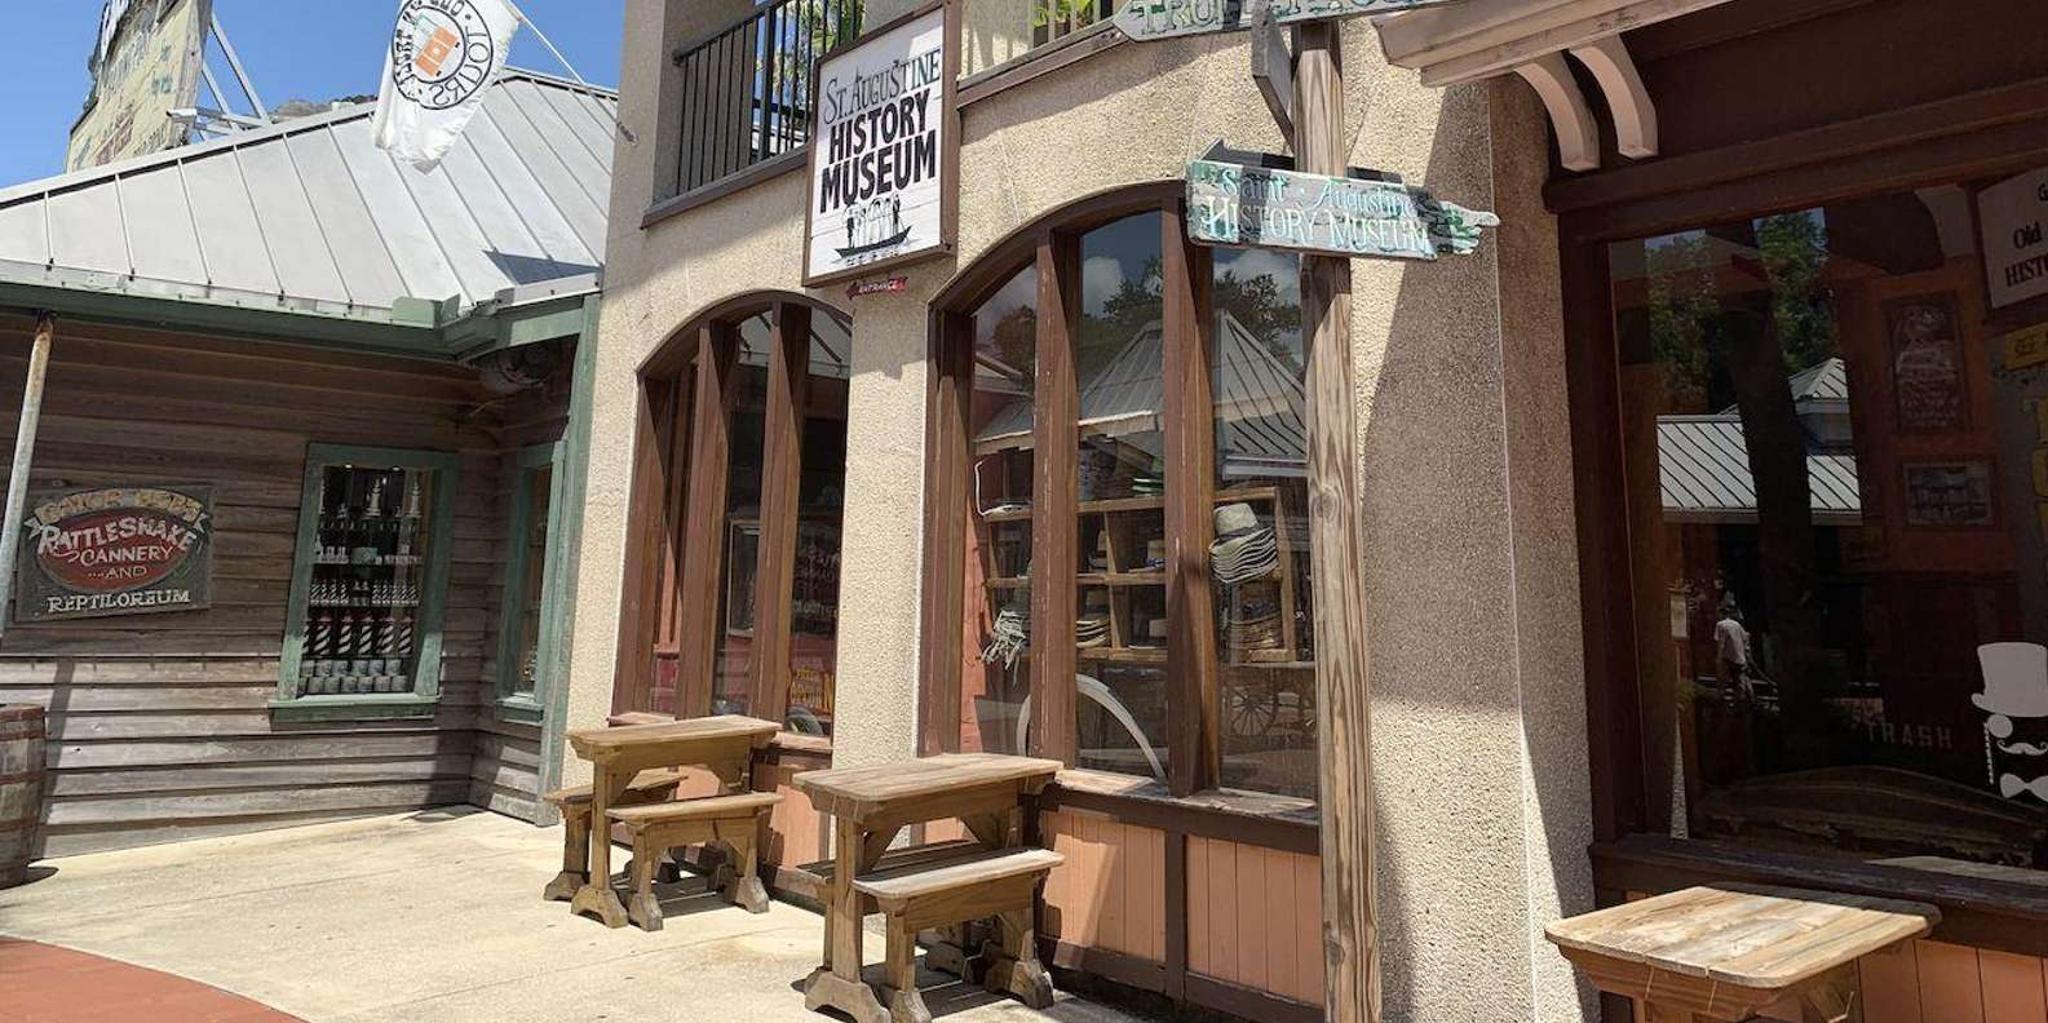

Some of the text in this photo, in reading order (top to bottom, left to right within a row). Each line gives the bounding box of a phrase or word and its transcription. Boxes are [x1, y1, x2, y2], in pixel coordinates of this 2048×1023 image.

[828, 88, 931, 165] HISTORY
[819, 129, 937, 214] MUSEUM
[1202, 195, 1431, 251] HISTORY MUSEUM
[2013, 222, 2042, 251] Old
[79, 545, 174, 567] CANNERY
[47, 588, 191, 613] REPTILOREUM
